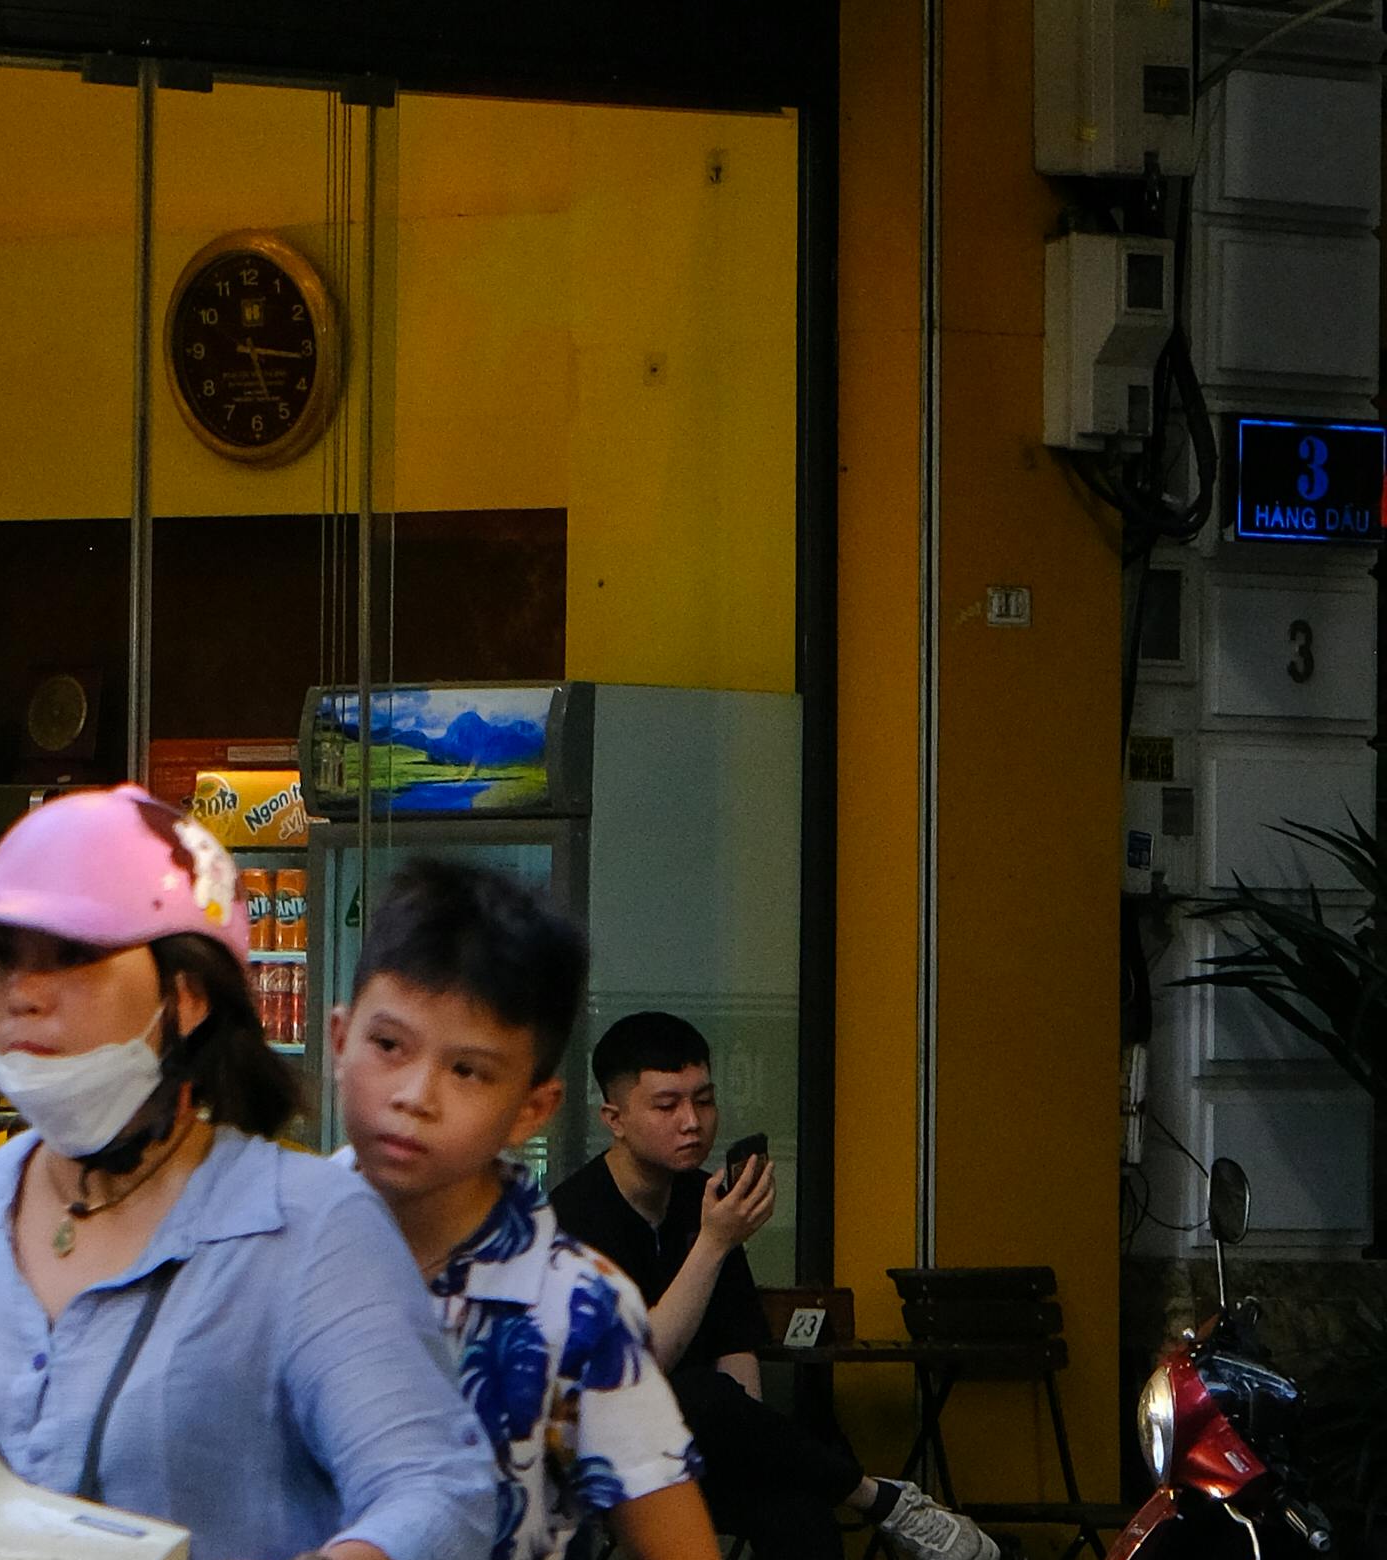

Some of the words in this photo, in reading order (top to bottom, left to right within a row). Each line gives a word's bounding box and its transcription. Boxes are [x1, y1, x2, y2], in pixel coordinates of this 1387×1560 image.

[239, 269, 258, 285] 12
[217, 281, 230, 296] 11
[200, 308, 218, 325] 10
[292, 305, 304, 320] 2
[193, 343, 205, 360] 9
[203, 379, 215, 396] 8
[223, 404, 235, 421] 7
[279, 403, 290, 419] 5
[251, 415, 263, 431] 6
[1296, 434, 1329, 500] 3
[1255, 499, 1316, 530] HÀNG
[1287, 620, 1314, 684] 3
[791, 1315, 817, 1337] 23
